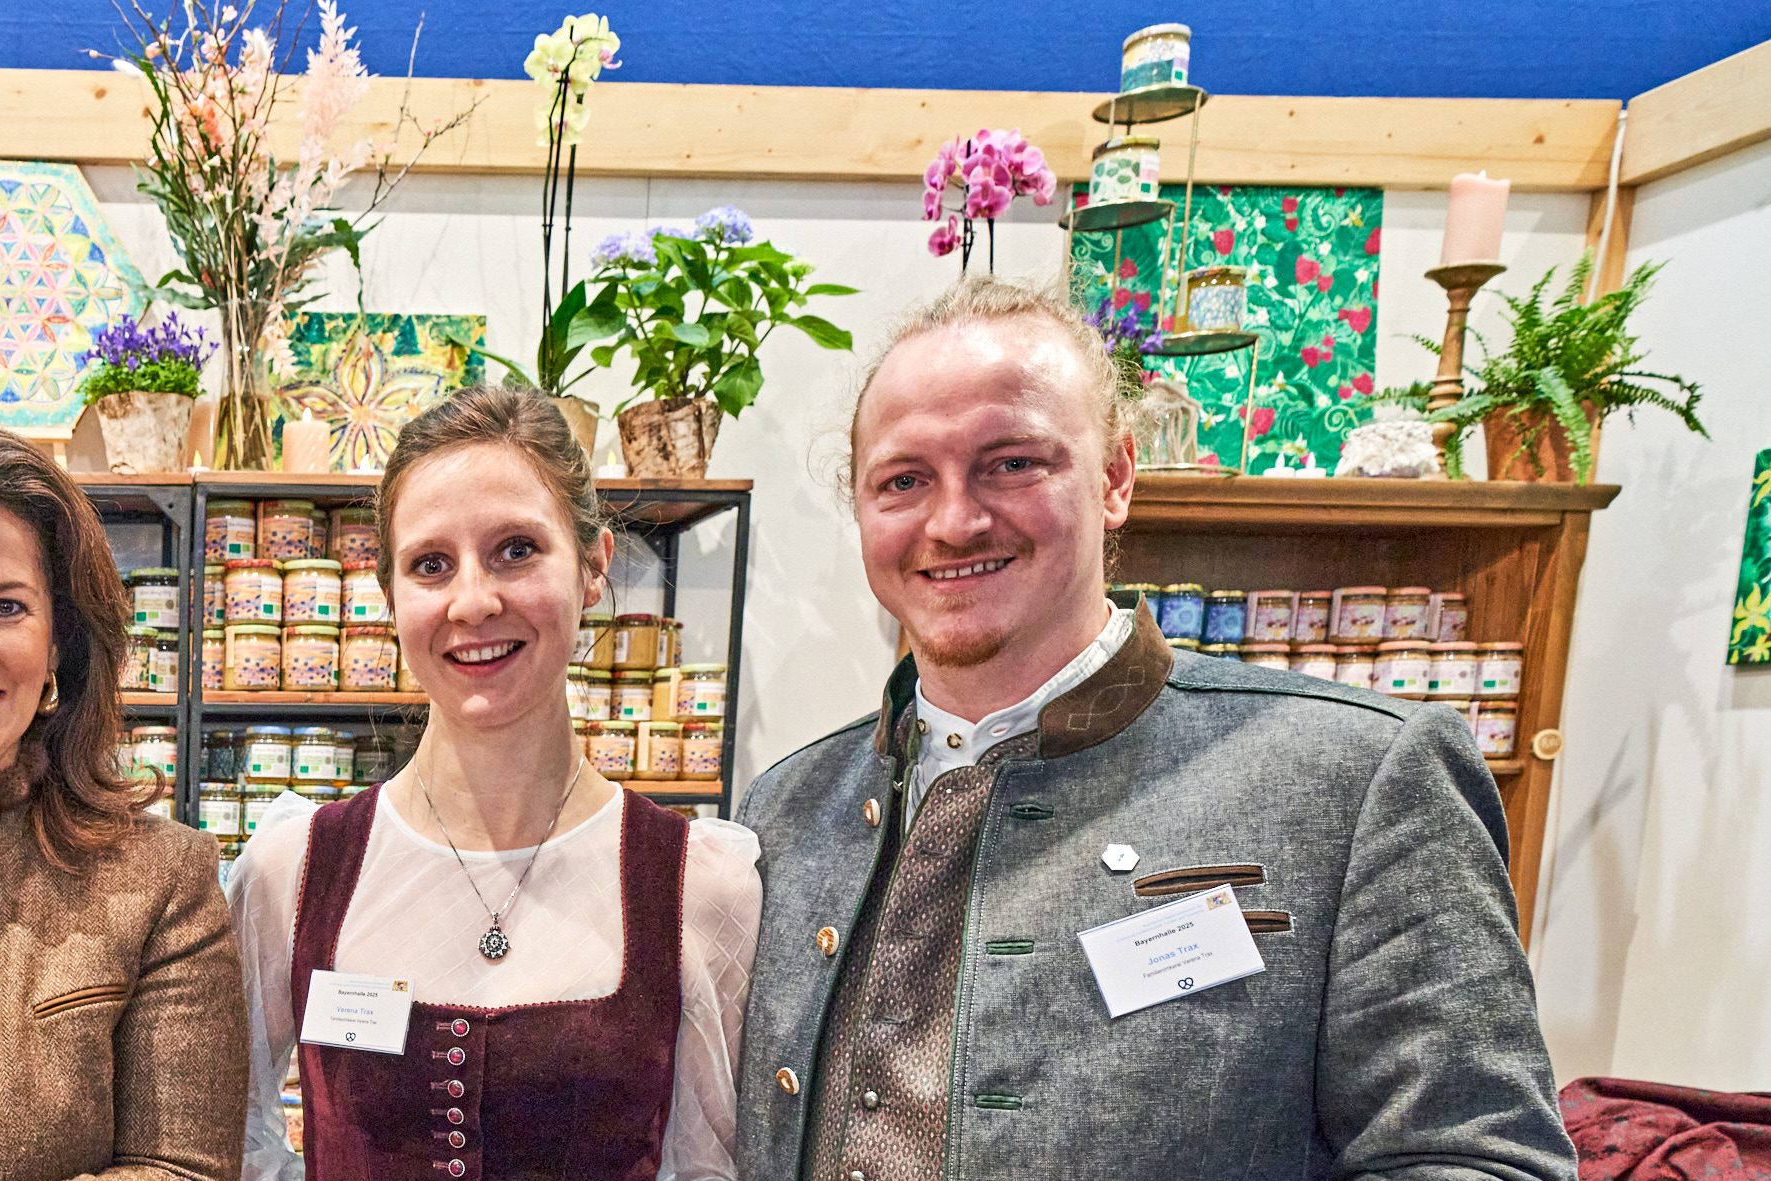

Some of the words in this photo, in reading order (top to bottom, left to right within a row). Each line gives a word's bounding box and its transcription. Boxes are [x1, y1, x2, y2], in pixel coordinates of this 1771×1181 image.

[1135, 928, 1177, 947] Bayernhalle
[1177, 921, 1195, 933] 2025
[1147, 950, 1176, 965] Jonas
[1177, 942, 1200, 955] Trax
[337, 989, 366, 997] Bayernhalle
[336, 1005, 359, 1014] Verena
